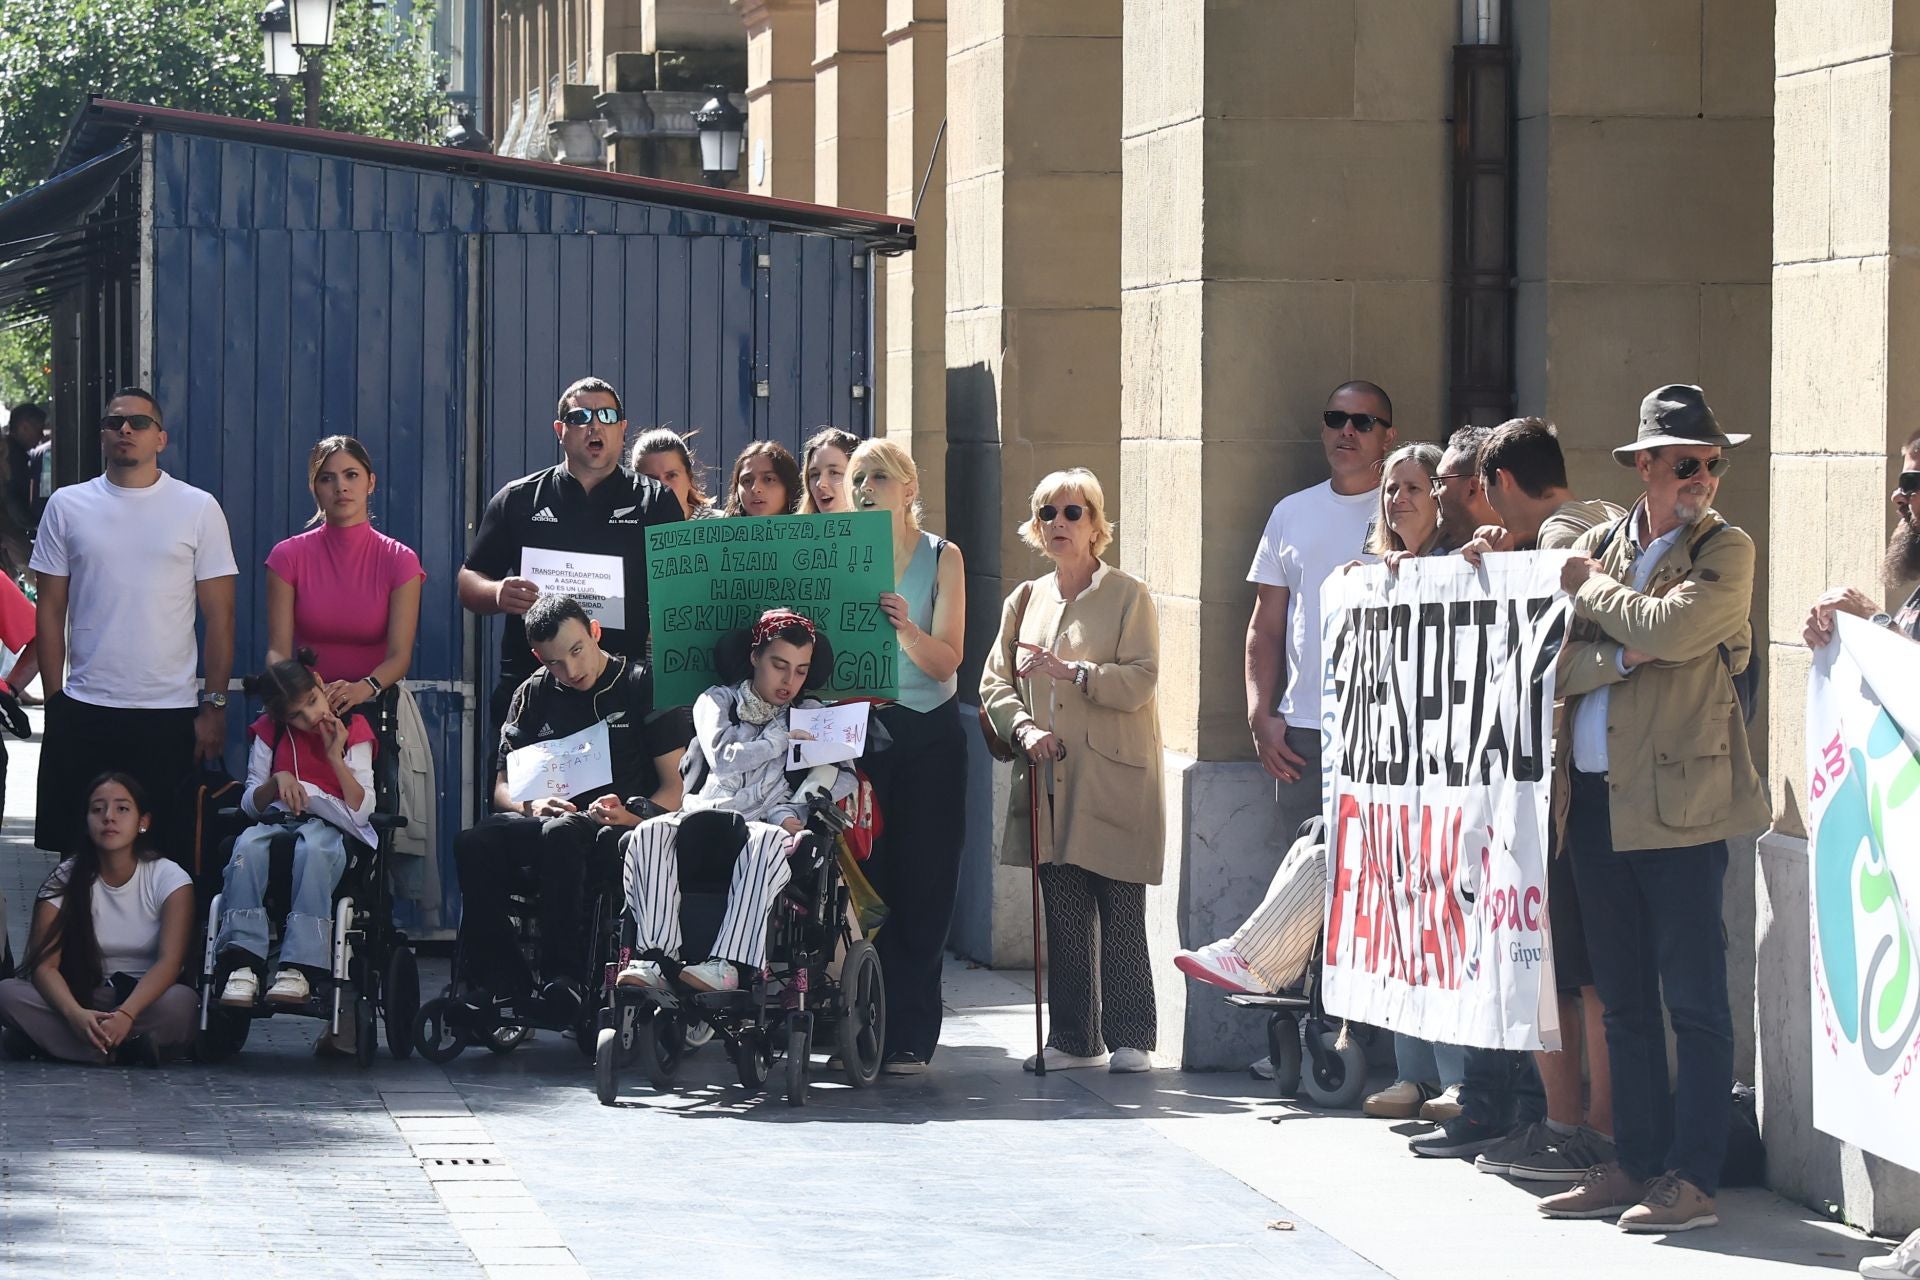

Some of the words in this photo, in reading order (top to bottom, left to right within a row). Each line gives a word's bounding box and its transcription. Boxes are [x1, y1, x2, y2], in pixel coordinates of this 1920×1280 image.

[824, 520, 851, 538] EZ
[652, 553, 708, 579] ZARA
[711, 578, 831, 600] HAURREN
[840, 602, 880, 632] EZ
